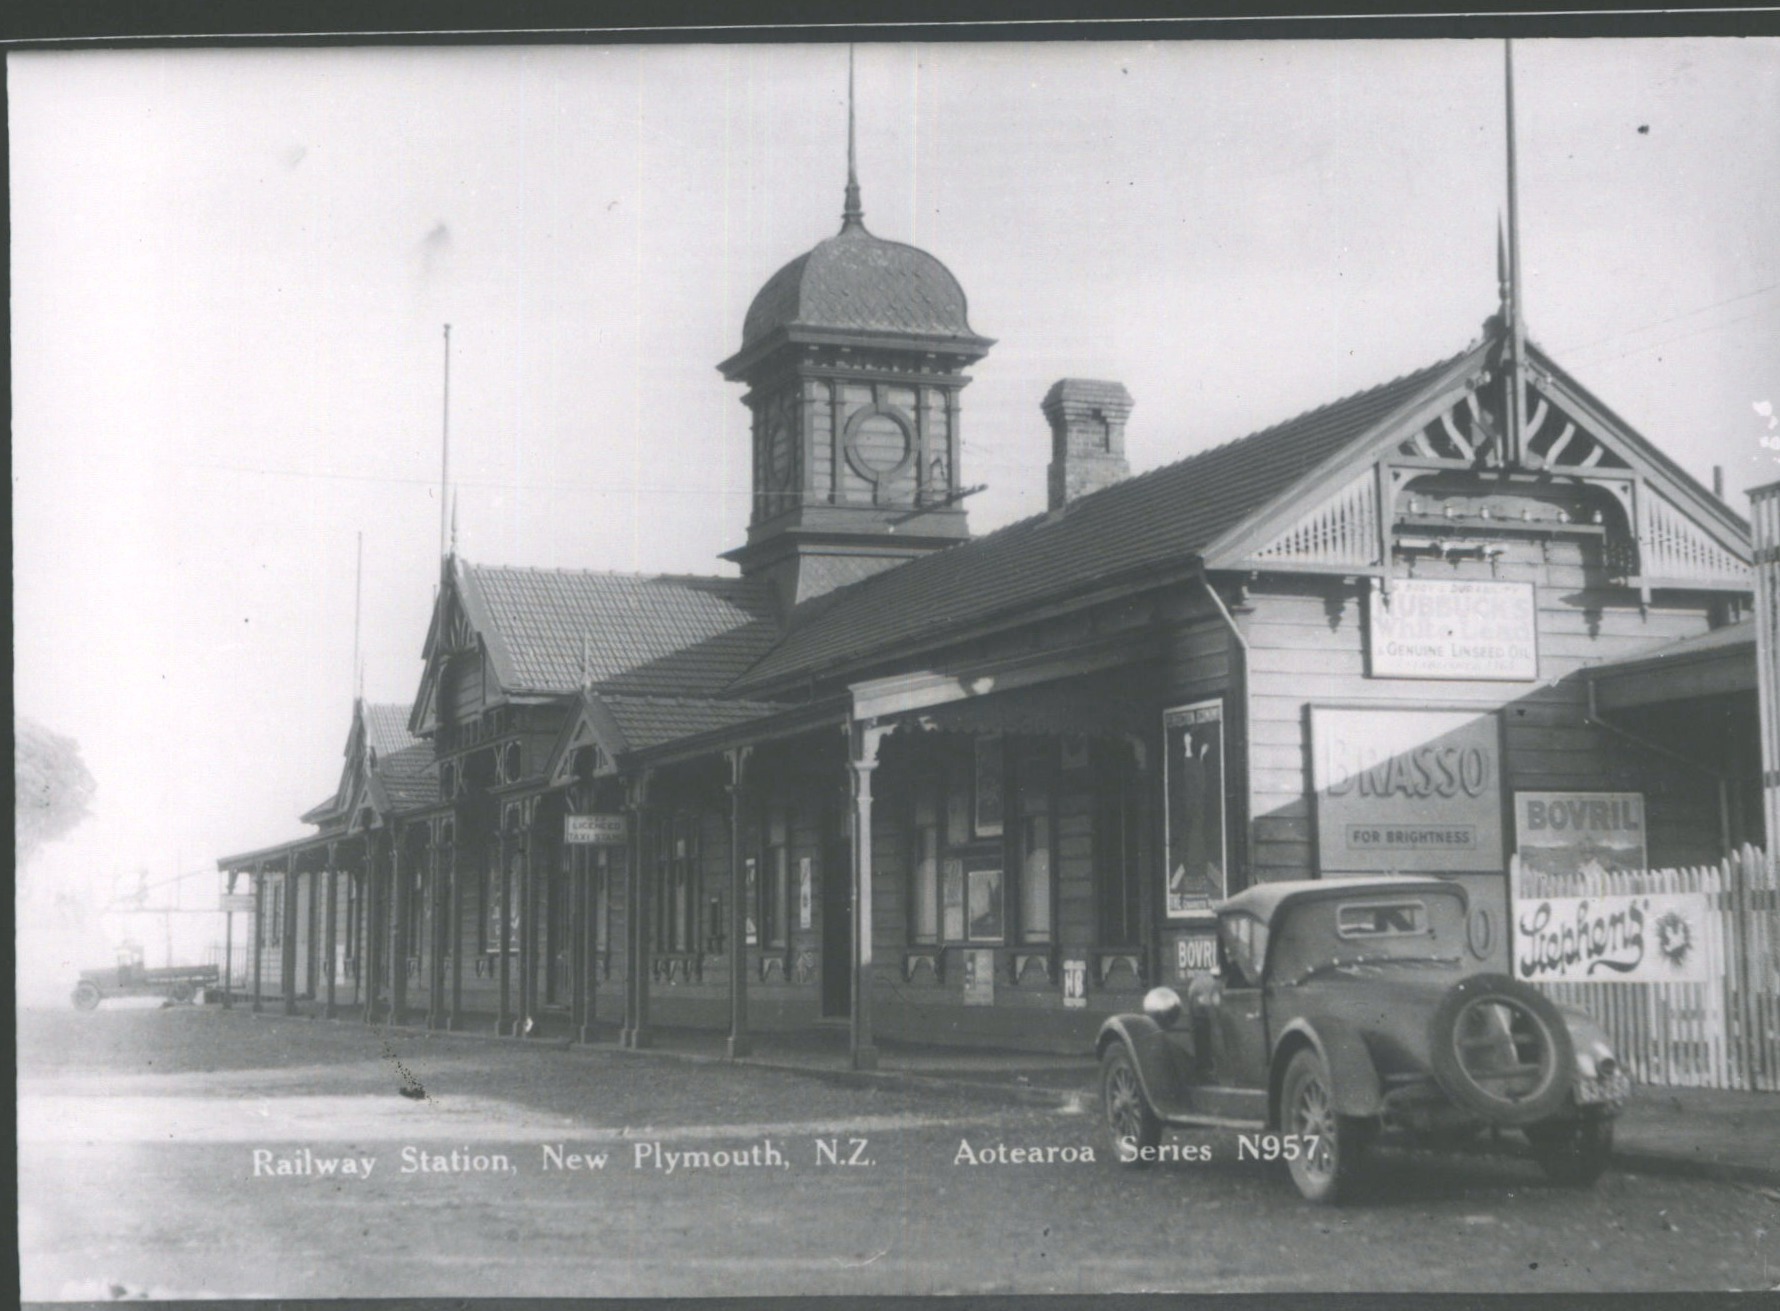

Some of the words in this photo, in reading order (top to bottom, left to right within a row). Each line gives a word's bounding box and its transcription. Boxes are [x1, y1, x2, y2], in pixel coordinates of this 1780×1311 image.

[1327, 735, 1489, 798] BRASSO
[1527, 800, 1639, 831] BOVRIL
[569, 832, 591, 841] TAXI
[1353, 830, 1381, 844] FOR
[1386, 830, 1470, 844] BRIGHTNESS
[1178, 940, 1217, 969] BOVRI
